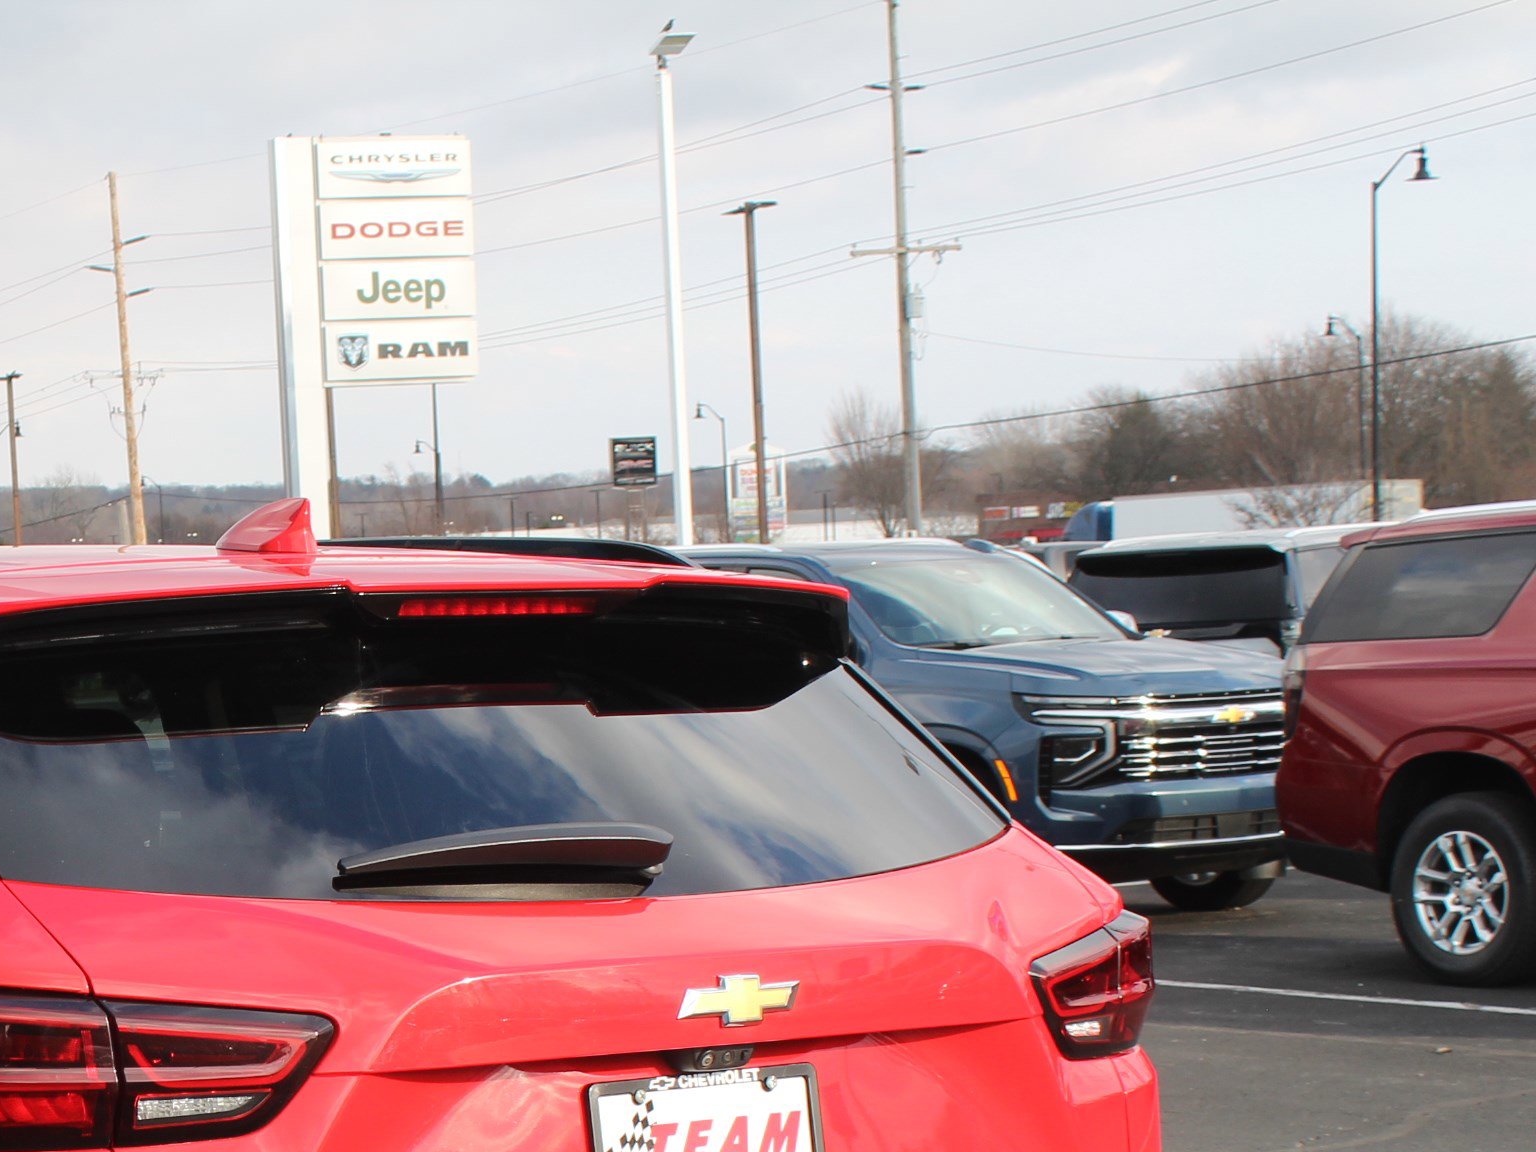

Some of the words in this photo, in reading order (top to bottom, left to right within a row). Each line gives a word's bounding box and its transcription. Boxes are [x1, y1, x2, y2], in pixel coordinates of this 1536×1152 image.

[330, 153, 458, 165] CHRYSLER
[330, 220, 465, 240] DODGE
[356, 271, 446, 309] Jeep
[377, 340, 469, 359] RAM
[677, 1068, 760, 1089] CHEVROLET
